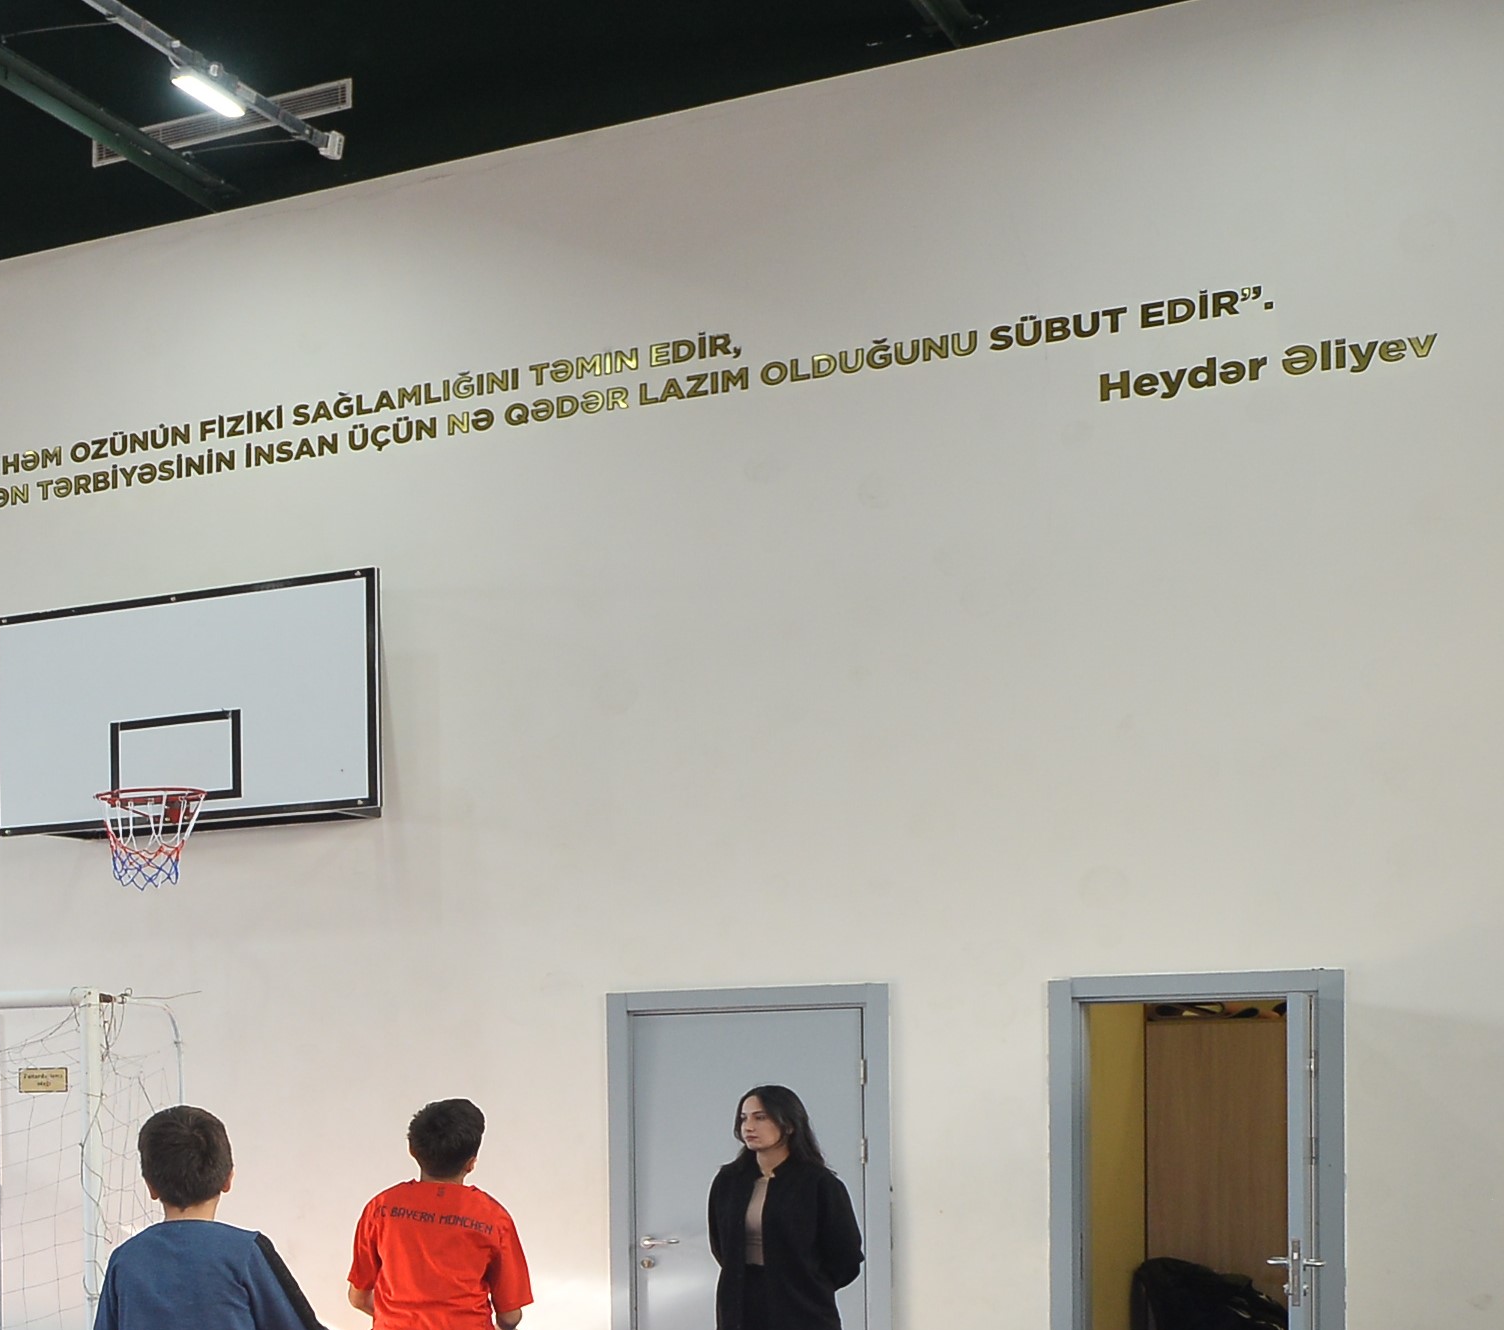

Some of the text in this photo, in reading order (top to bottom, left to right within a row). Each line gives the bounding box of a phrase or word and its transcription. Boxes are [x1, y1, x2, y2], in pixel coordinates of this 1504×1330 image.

[2, 446, 62, 475] HƏM
[293, 368, 519, 426] SAĞLAMLIĞINI
[649, 331, 742, 367] EDİR,
[37, 449, 235, 500] TƏRBİYƏSİNİN
[245, 433, 338, 468] İNSAN
[348, 416, 437, 451] ÜÇÜN
[447, 409, 494, 435] NƏ
[504, 386, 629, 426] QƏDƏR
[639, 367, 749, 405] LAZIM
[760, 330, 978, 386] OLDUĞUNU
[989, 307, 1127, 351] SÜBUT
[1099, 333, 1438, 402] Heydər Əliyev
[390, 1206, 435, 1224] BAYERN
